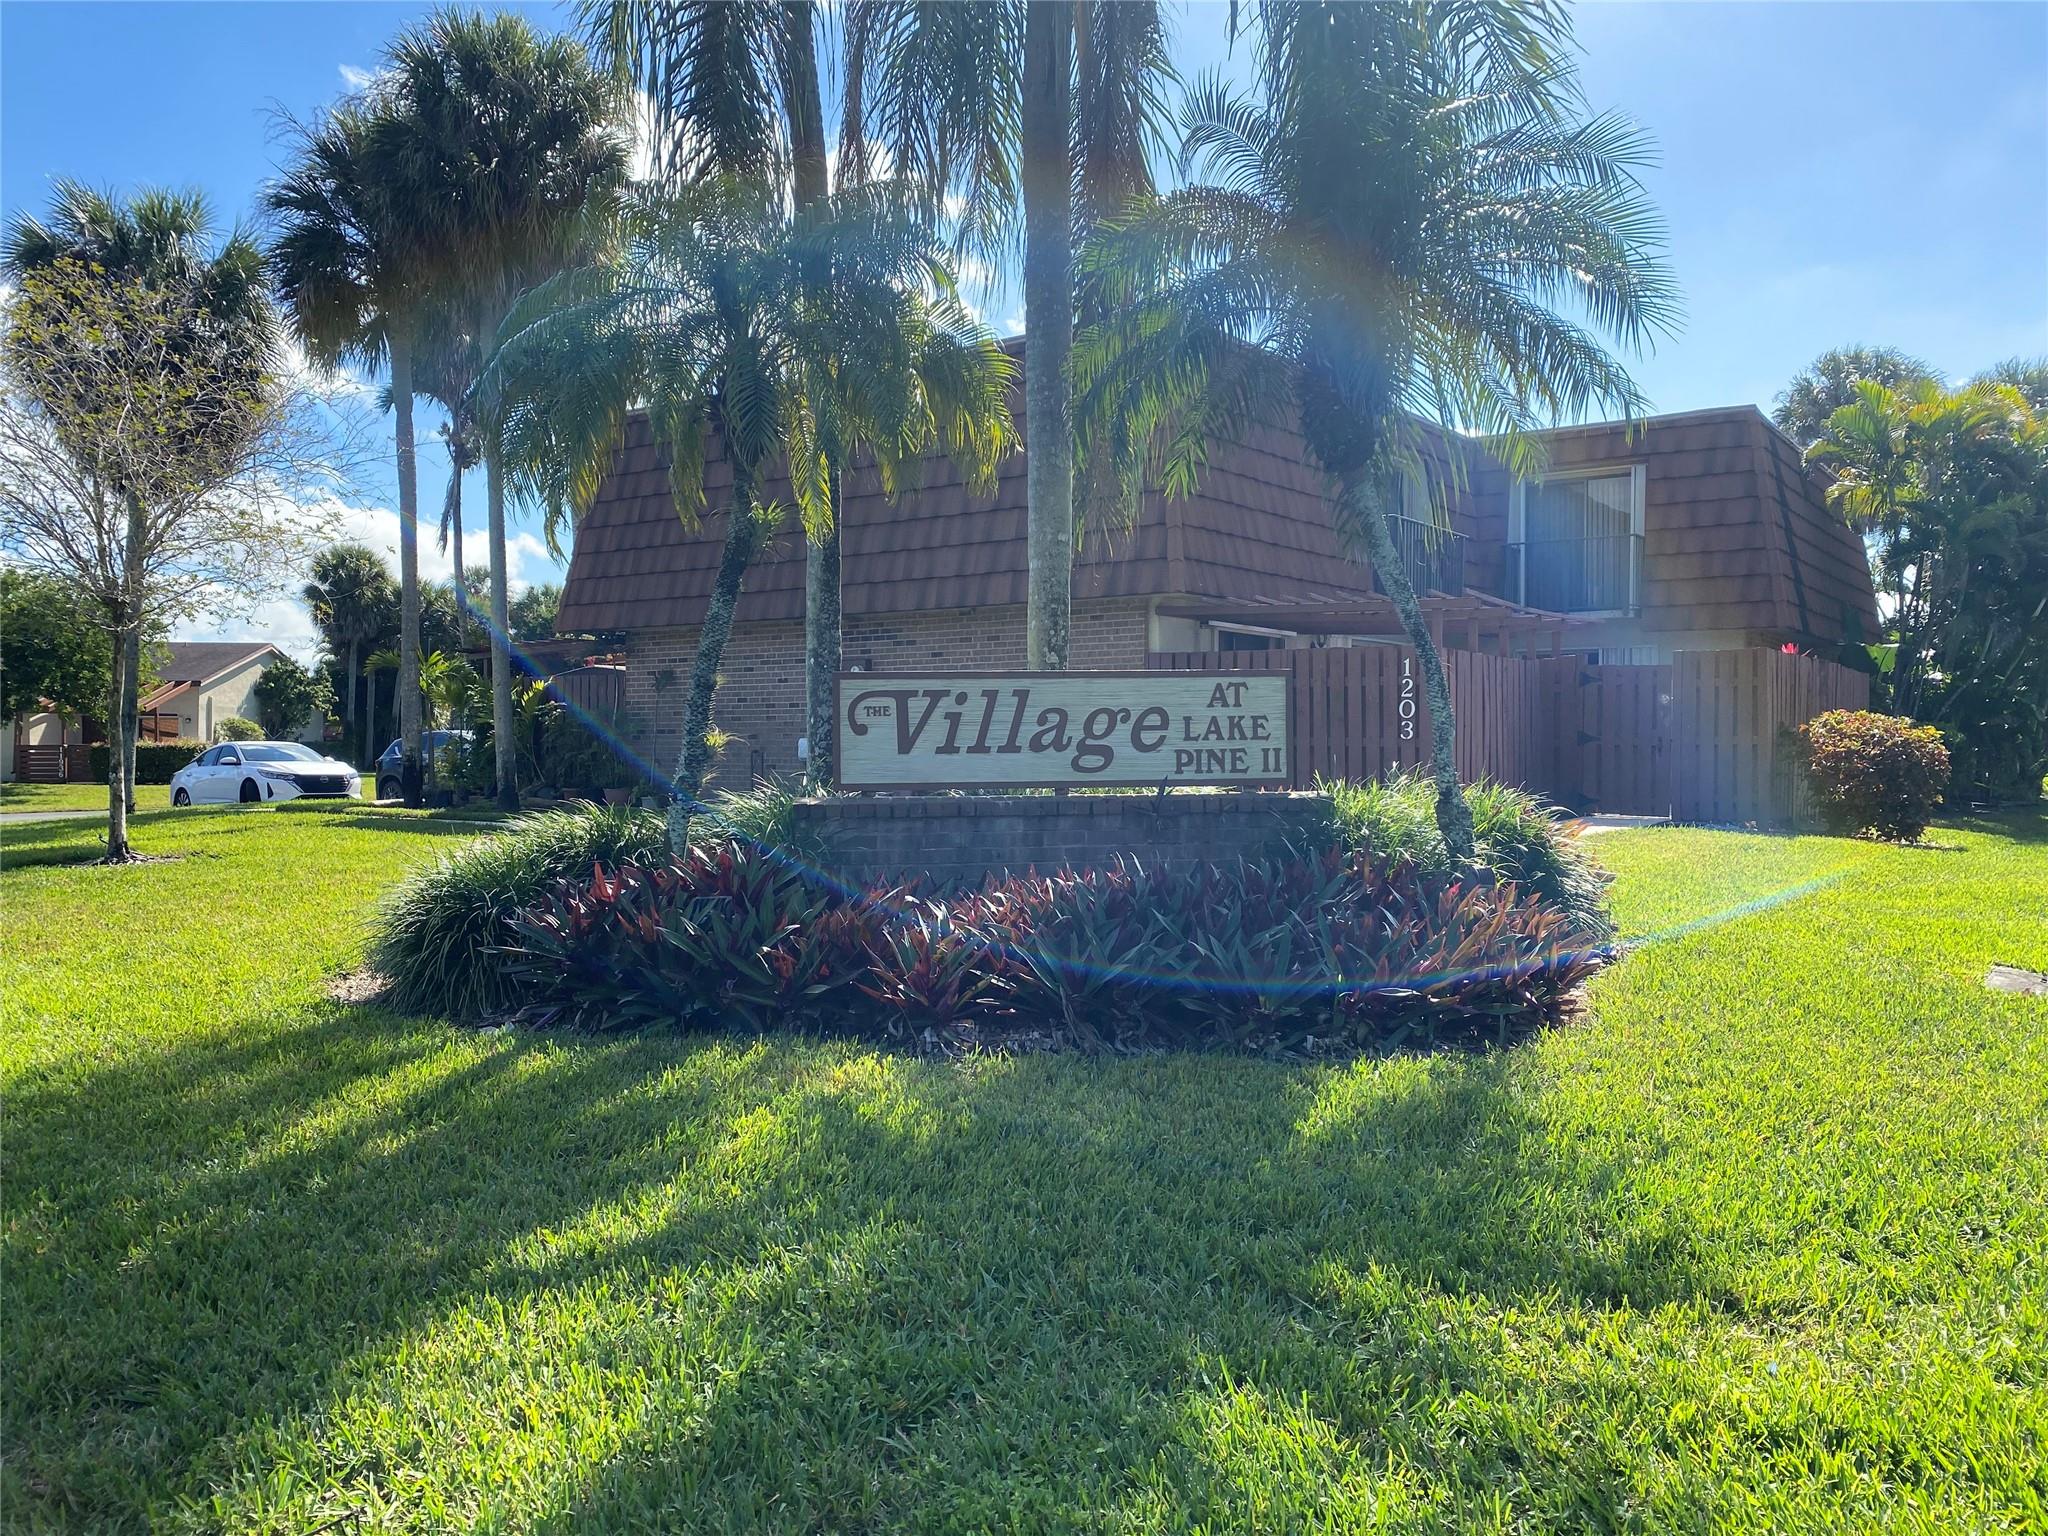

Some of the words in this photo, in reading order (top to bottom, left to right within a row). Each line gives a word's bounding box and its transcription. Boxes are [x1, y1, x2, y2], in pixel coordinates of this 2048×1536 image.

[1206, 682, 1249, 708] AT
[1399, 657, 1416, 740] 1203
[863, 705, 892, 717] THE
[847, 689, 1170, 774] Village
[1182, 715, 1271, 742] LAKE
[1174, 748, 1250, 774] PINE
[1261, 748, 1282, 773] II
